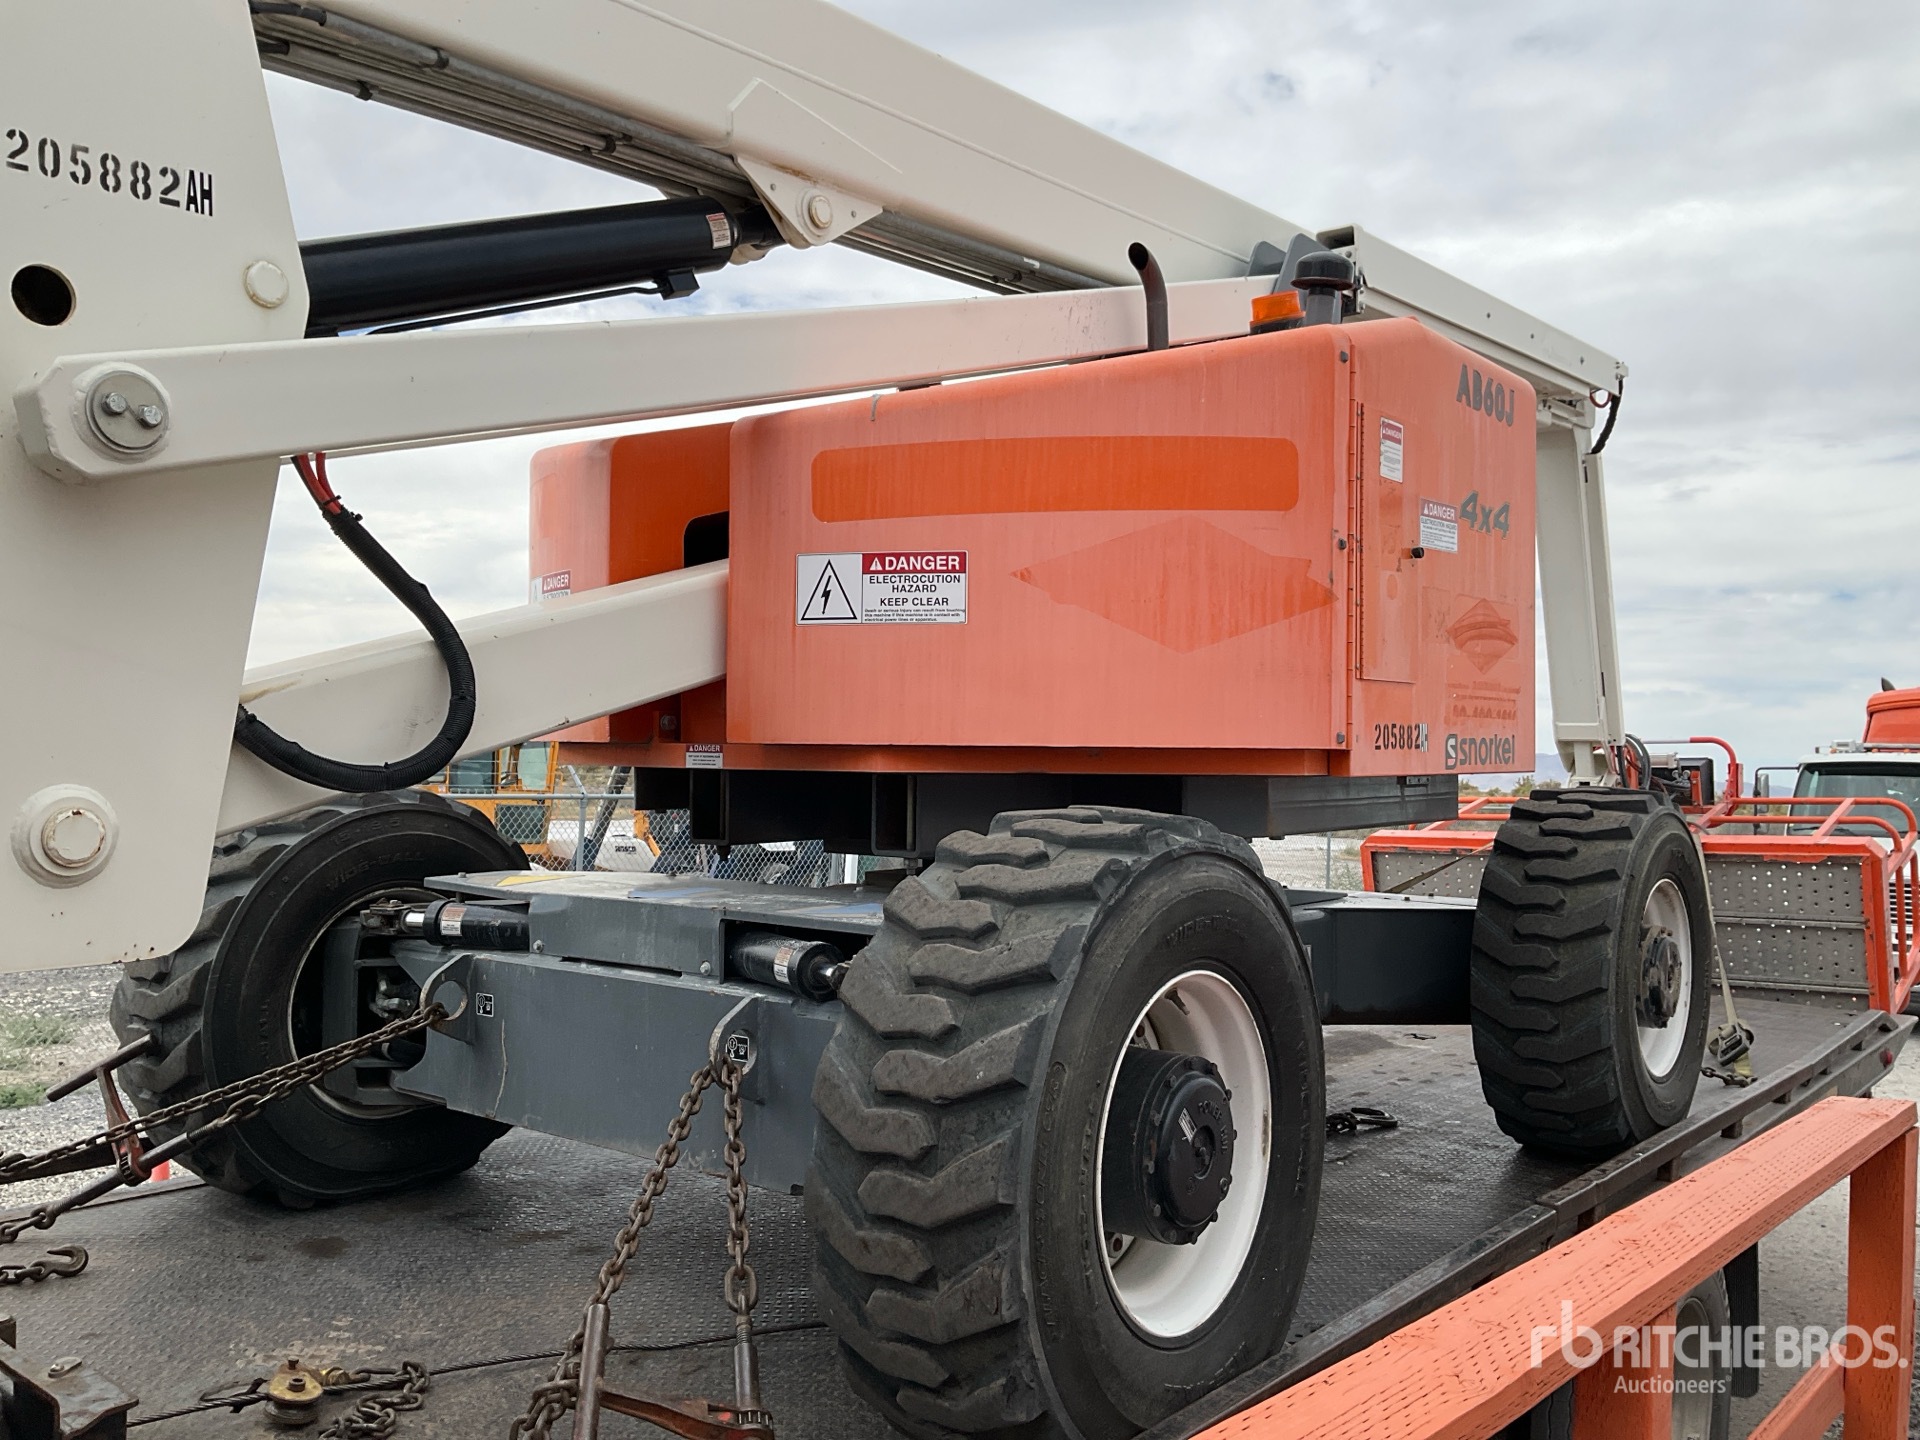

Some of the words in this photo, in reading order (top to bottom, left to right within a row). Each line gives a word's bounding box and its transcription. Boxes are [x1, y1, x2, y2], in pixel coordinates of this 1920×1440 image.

[1456, 364, 1515, 427] AB60J
[1429, 503, 1455, 521] DANGER
[1459, 490, 1511, 540] 4x4
[885, 555, 960, 571] DANGER
[869, 574, 961, 585] ELECTROCUTION
[891, 584, 937, 593] HAZARD
[880, 597, 908, 607] KEEP
[912, 597, 949, 607] CLEAR
[694, 744, 720, 752] DANGER
[1459, 733, 1515, 766] snorkel
